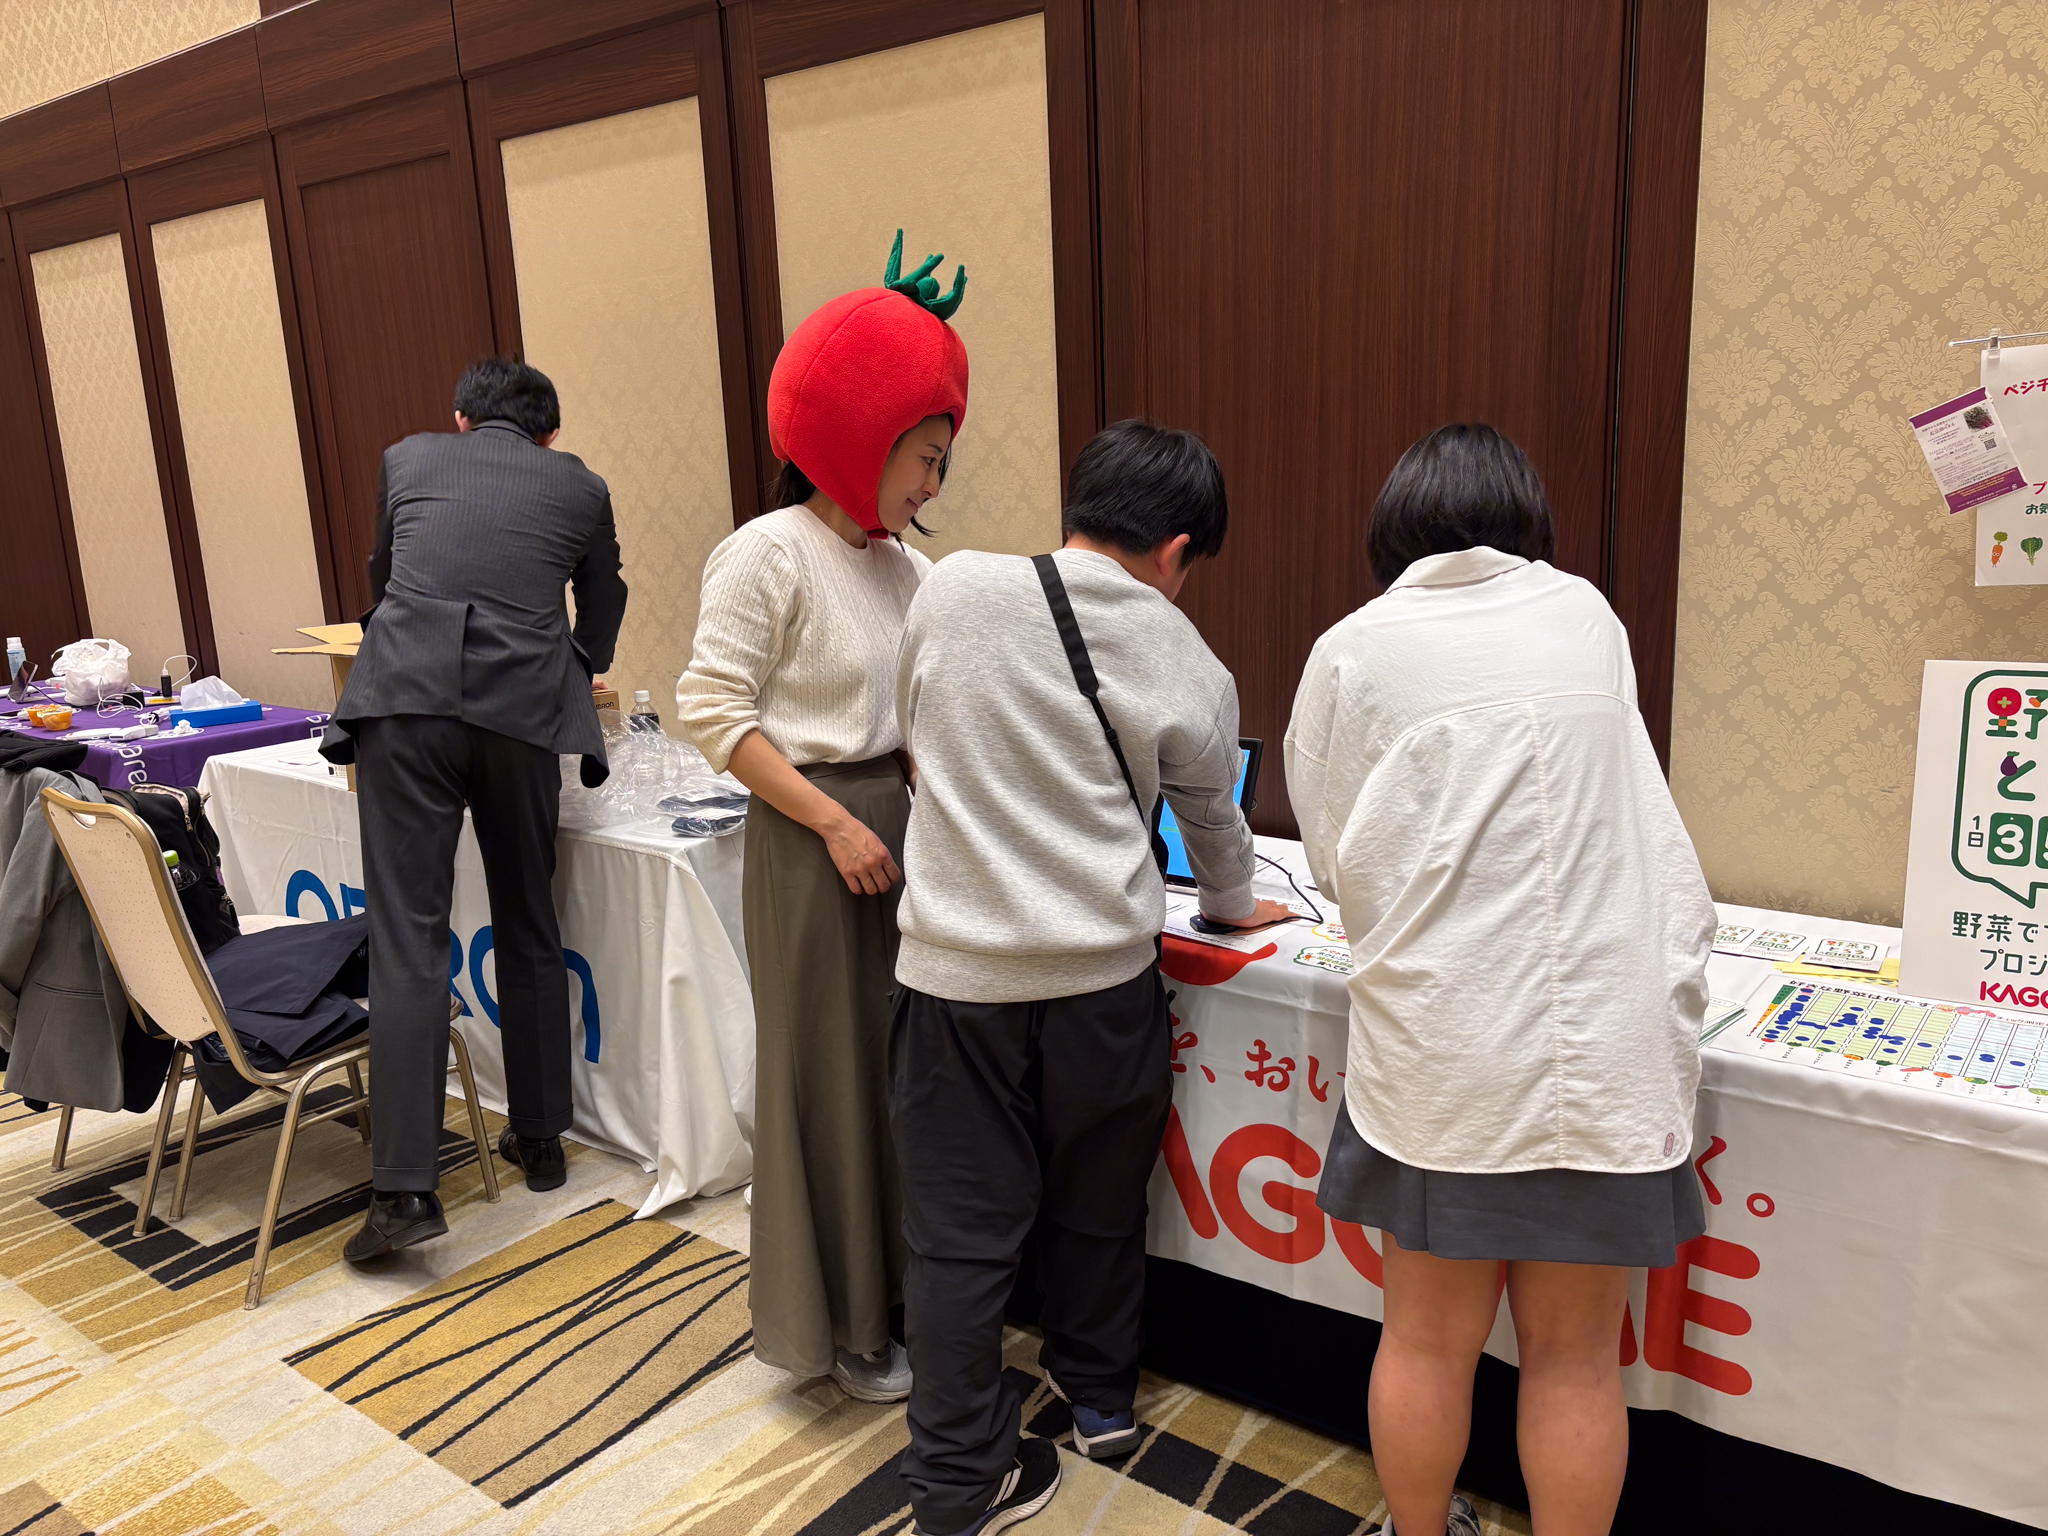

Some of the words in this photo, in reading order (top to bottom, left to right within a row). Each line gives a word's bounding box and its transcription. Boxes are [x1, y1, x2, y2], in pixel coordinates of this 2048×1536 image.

[596, 701, 615, 710] MRON
[1952, 911, 2048, 943] 野菜で
[1789, 980, 1935, 1009] 好きな野菜は何です
